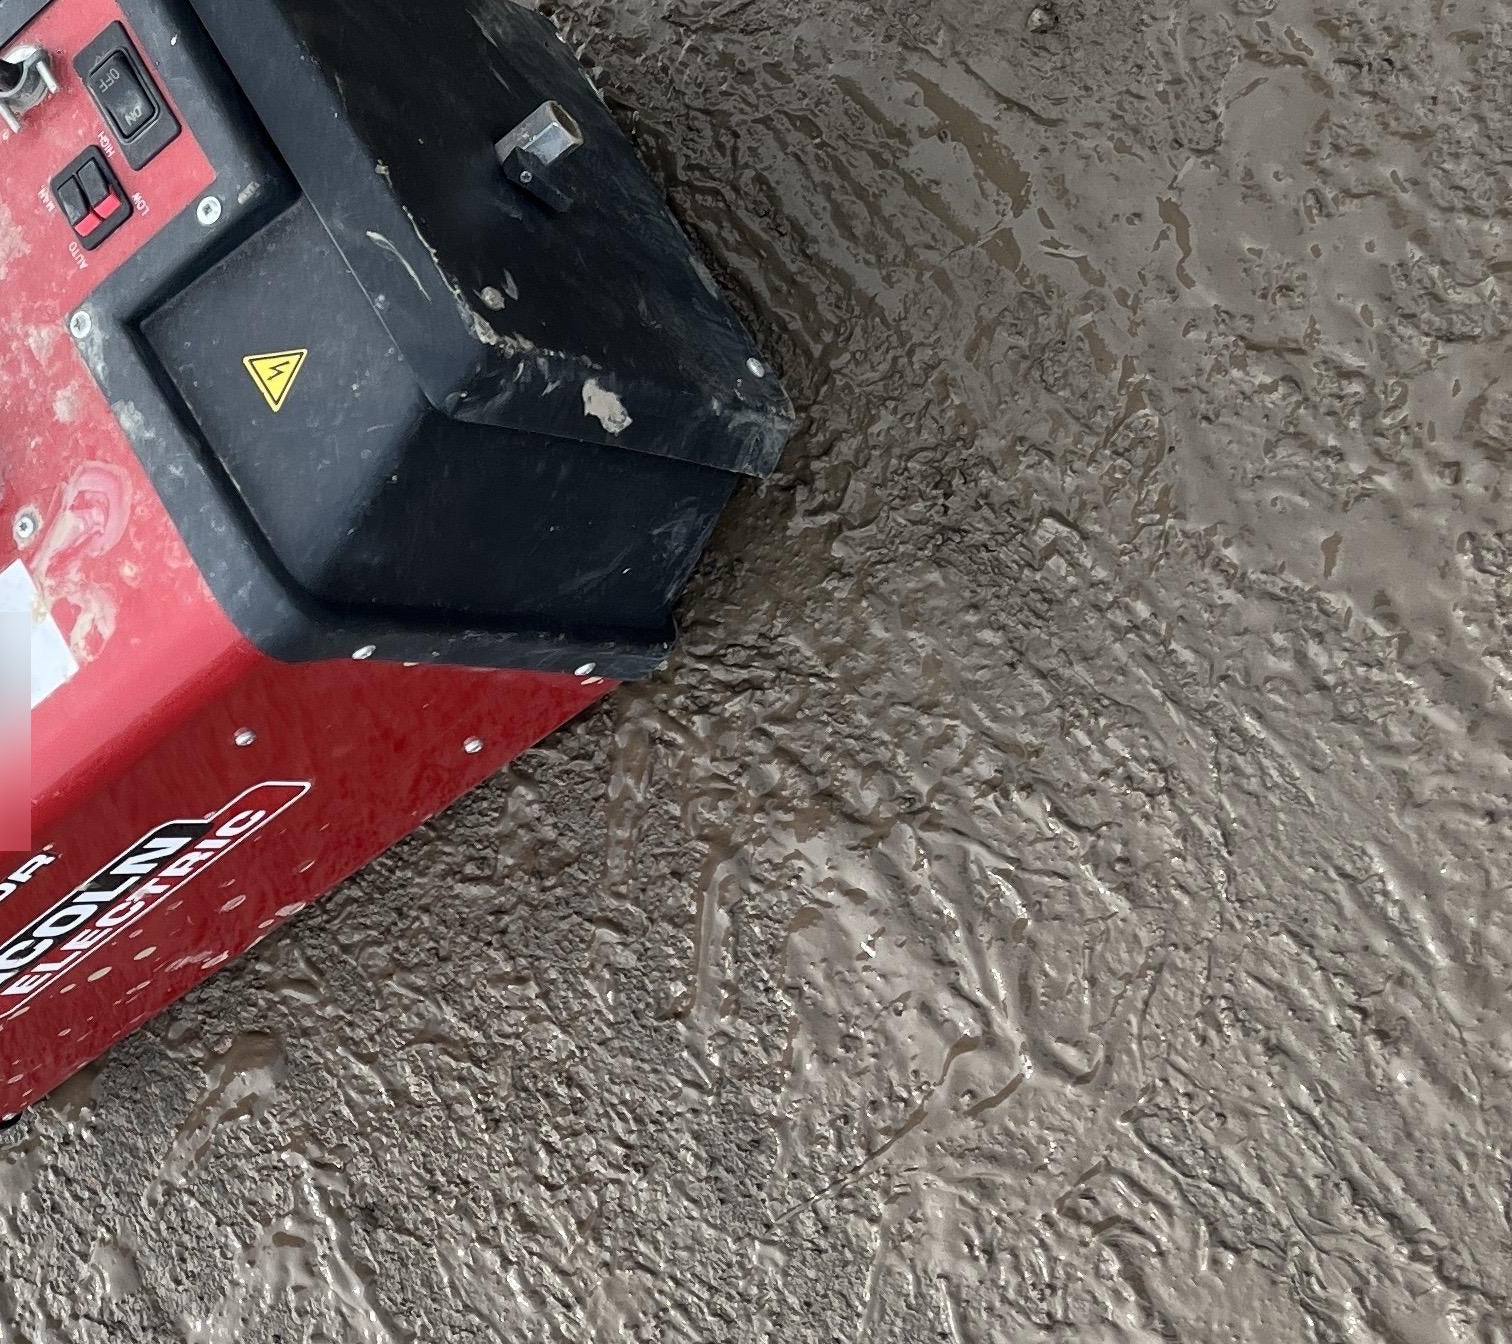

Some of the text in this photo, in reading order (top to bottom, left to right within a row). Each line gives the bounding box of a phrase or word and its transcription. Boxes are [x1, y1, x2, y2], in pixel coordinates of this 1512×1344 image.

[98, 68, 121, 93] OFF
[124, 105, 142, 126] ON
[97, 131, 116, 158] HIGH
[132, 192, 150, 216] LOW
[68, 240, 89, 270] AUTO
[2, 807, 269, 997] ELECTRIC
